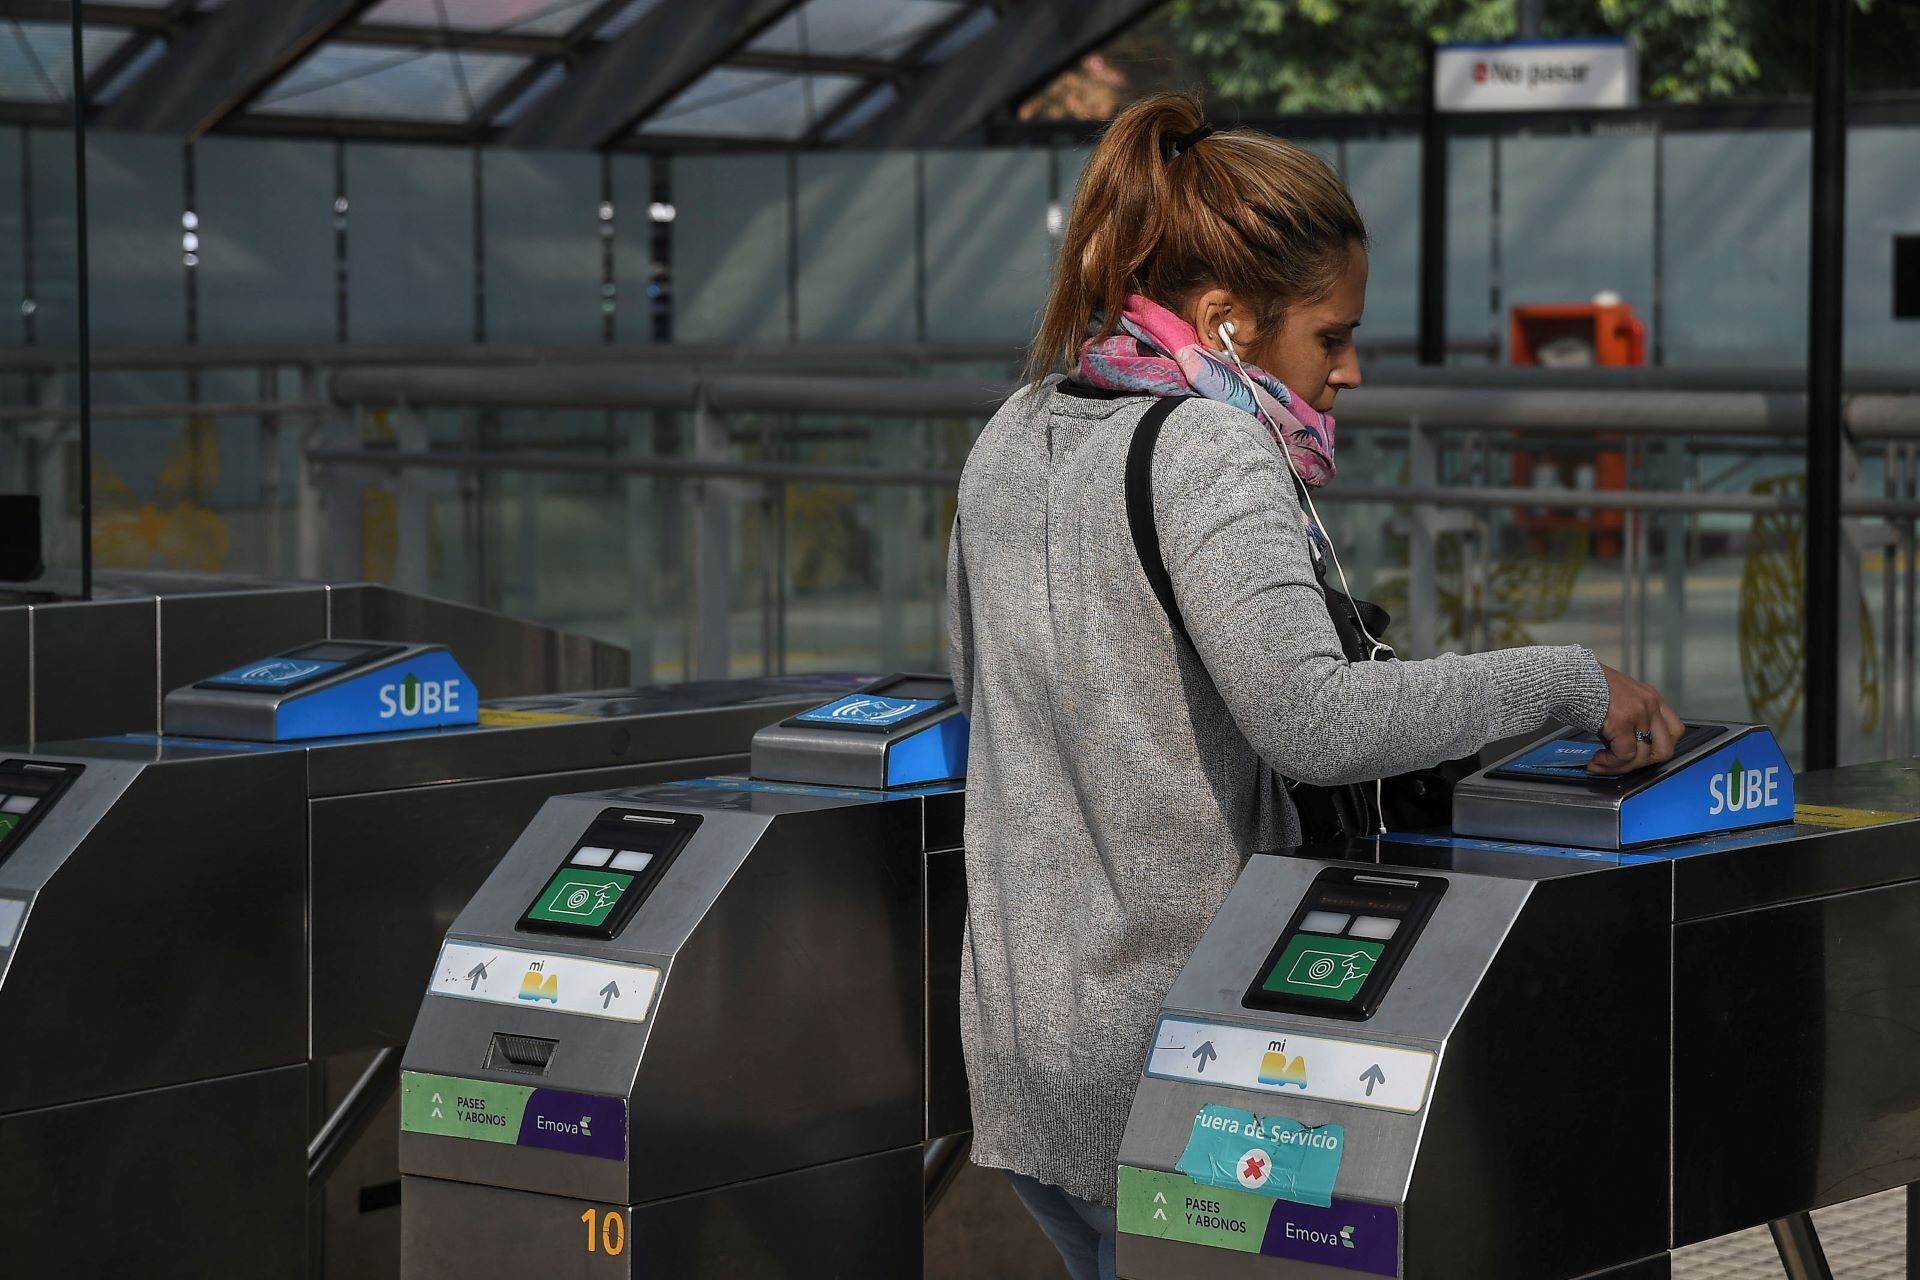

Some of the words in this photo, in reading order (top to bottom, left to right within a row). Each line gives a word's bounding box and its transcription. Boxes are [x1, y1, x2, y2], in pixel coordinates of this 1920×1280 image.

[1492, 62, 1522, 83] No
[1528, 63, 1590, 88] pasar
[379, 679, 460, 718] SUBE
[1709, 766, 1779, 815] SUBE
[529, 960, 545, 972] mi
[518, 971, 558, 1004] BA
[1268, 1039, 1286, 1052] mi
[1258, 1052, 1307, 1089] BA
[457, 1096, 486, 1110] PASES
[457, 1110, 464, 1121] Y
[465, 1111, 507, 1127] ABONOS
[537, 1115, 578, 1134] Emova
[1243, 1118, 1266, 1140] de
[1270, 1125, 1339, 1150] Servicio
[1185, 1197, 1221, 1214] PASES
[581, 1208, 625, 1256] 10
[1185, 1212, 1193, 1225] Y
[1195, 1214, 1247, 1233] ABONOS
[1285, 1222, 1338, 1246] Emova
